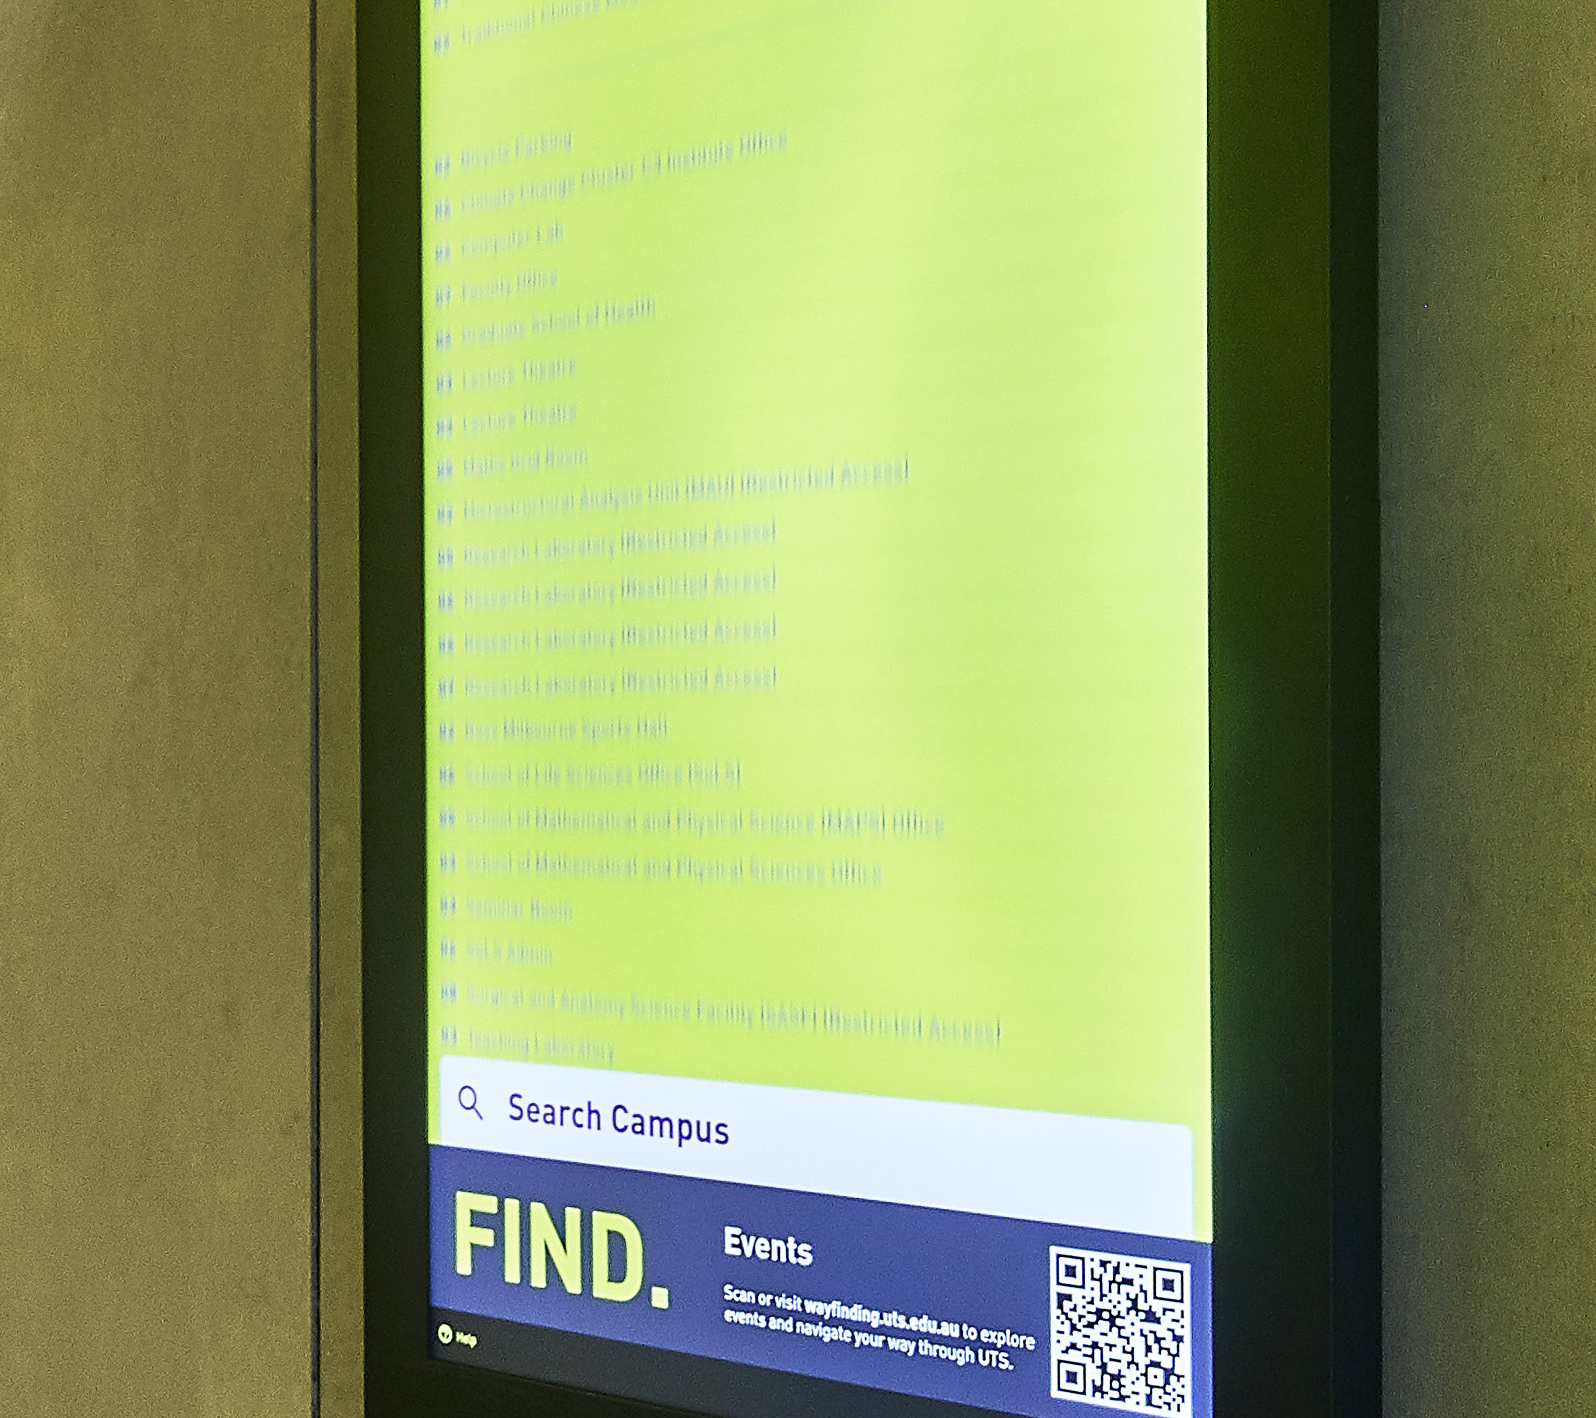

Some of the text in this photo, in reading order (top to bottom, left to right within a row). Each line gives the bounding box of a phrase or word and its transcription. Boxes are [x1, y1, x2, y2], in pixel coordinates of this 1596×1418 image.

[510, 1094, 728, 1147] Search Campus
[456, 1189, 668, 1311] FIND.
[725, 1225, 813, 1266] Events
[723, 1283, 1035, 1353] Scan or visit wayfinding.uts.edu.au to explore
[724, 1307, 1015, 1371] events and navigate your way through UTS.
